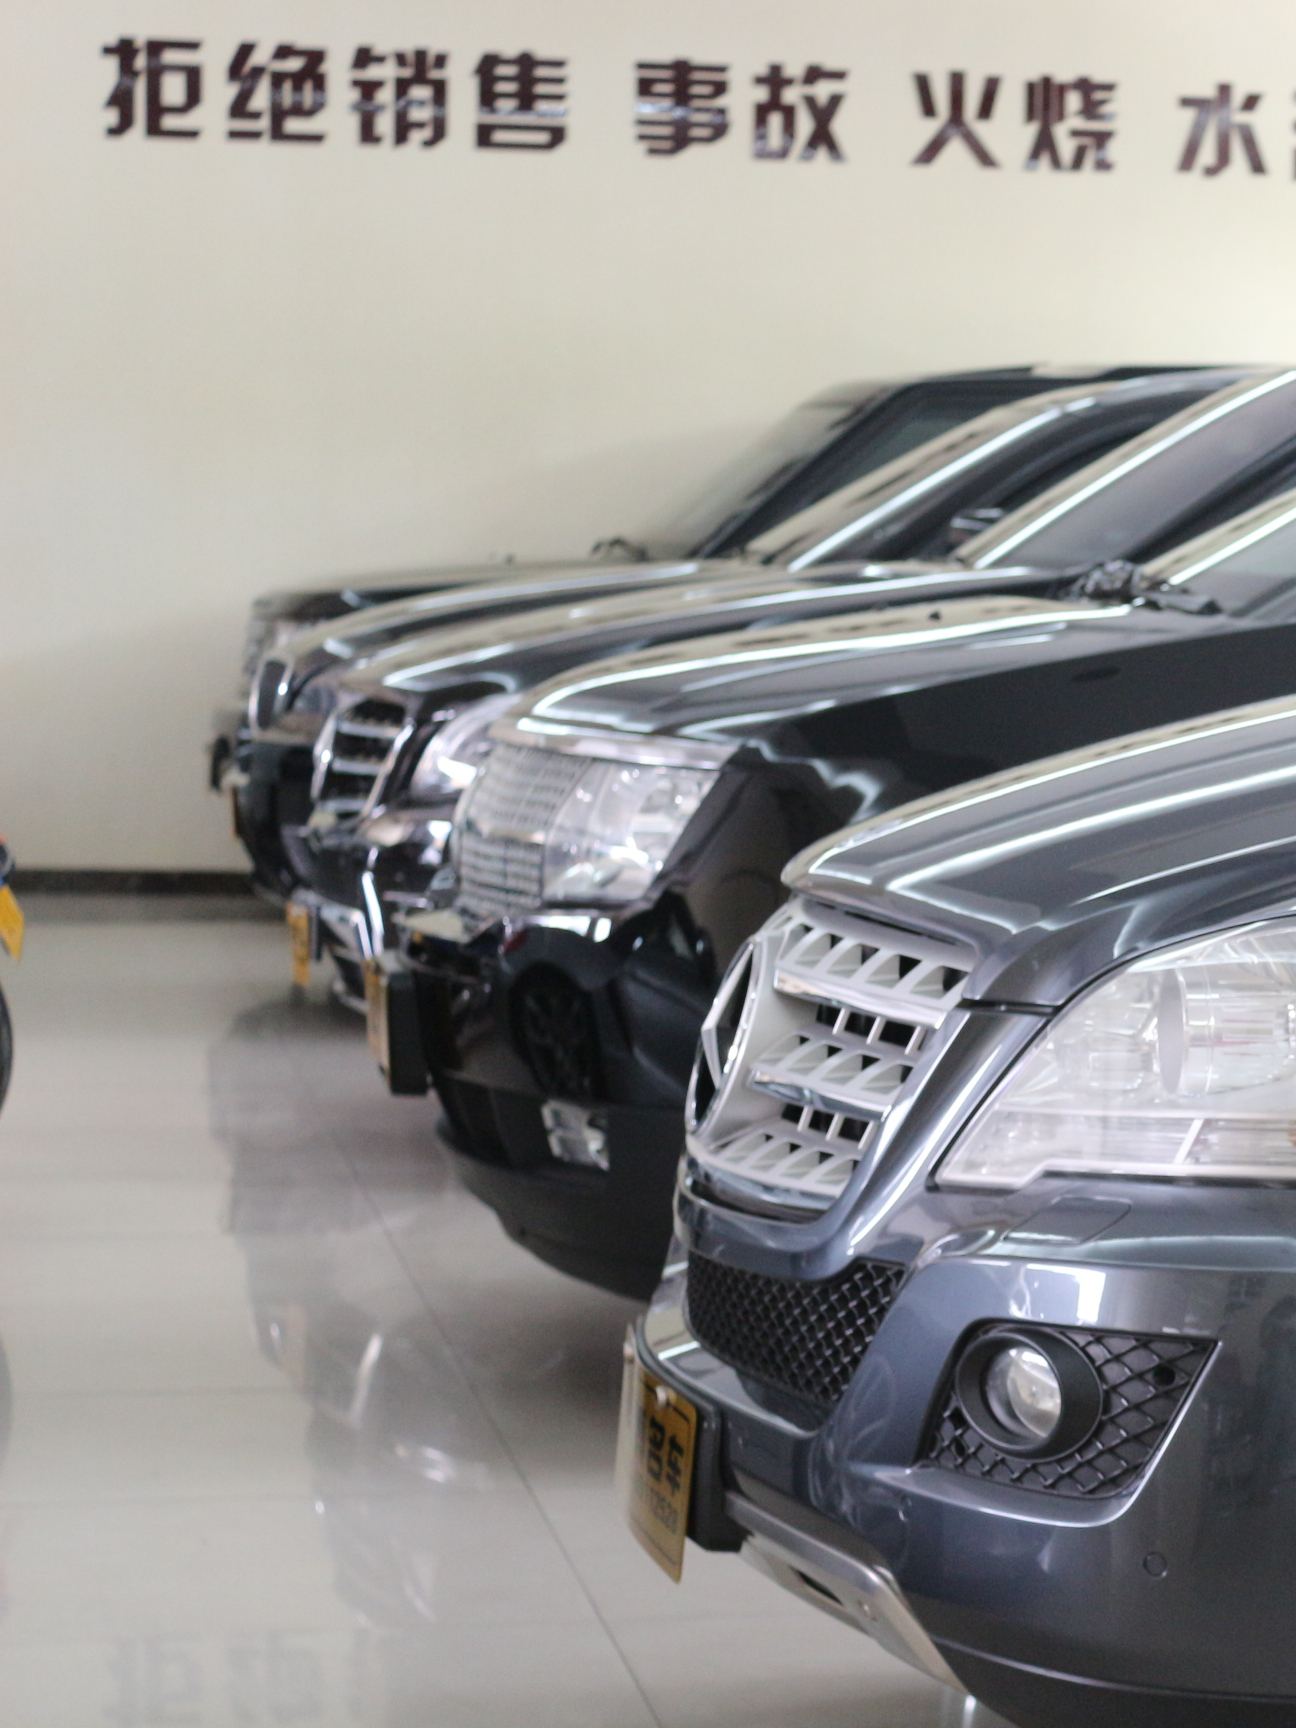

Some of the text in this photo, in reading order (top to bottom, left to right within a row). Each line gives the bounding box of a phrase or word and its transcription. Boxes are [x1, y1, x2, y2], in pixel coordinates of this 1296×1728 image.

[101, 36, 569, 152] 拒绝销售
[633, 57, 849, 163] 事故
[911, 69, 1118, 173] 火烧
